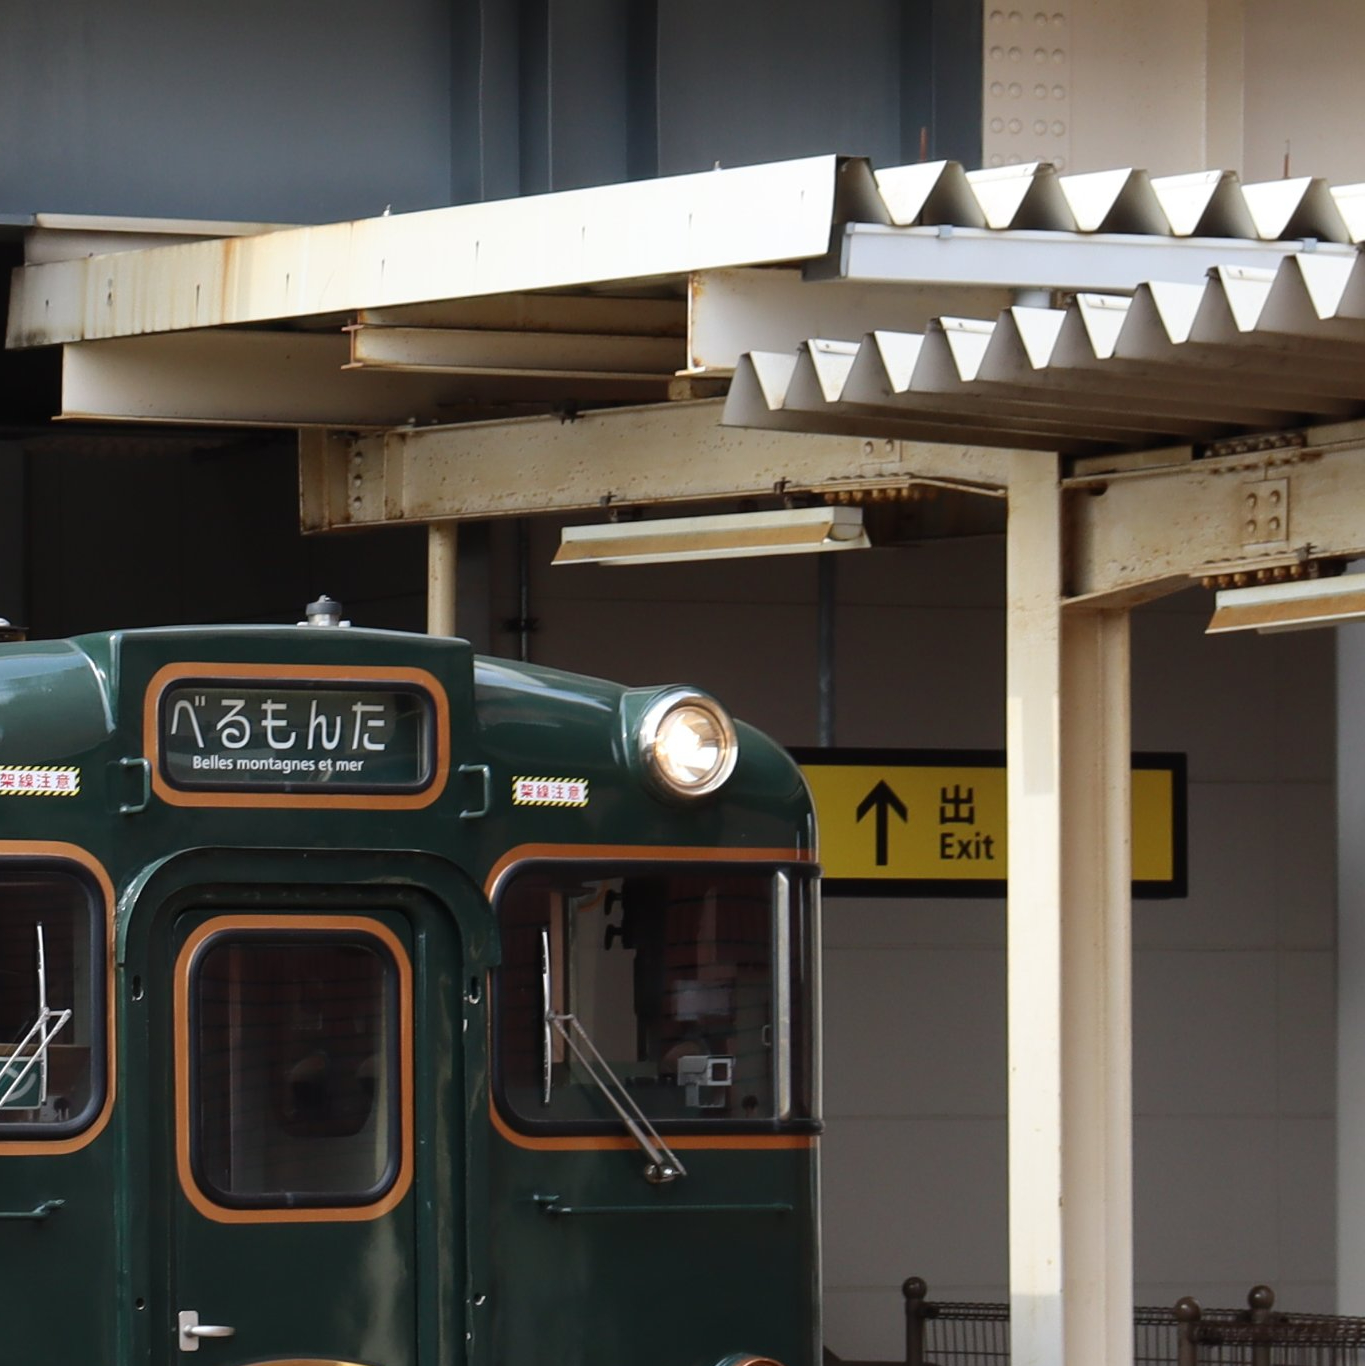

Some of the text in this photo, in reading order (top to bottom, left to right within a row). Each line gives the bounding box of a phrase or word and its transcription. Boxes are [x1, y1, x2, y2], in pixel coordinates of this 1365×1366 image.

[170, 695, 386, 751] べるもんた
[192, 755, 364, 774] Belles montagnes et mer
[0, 772, 70, 790] 架線注意
[940, 831, 995, 860] Exit
